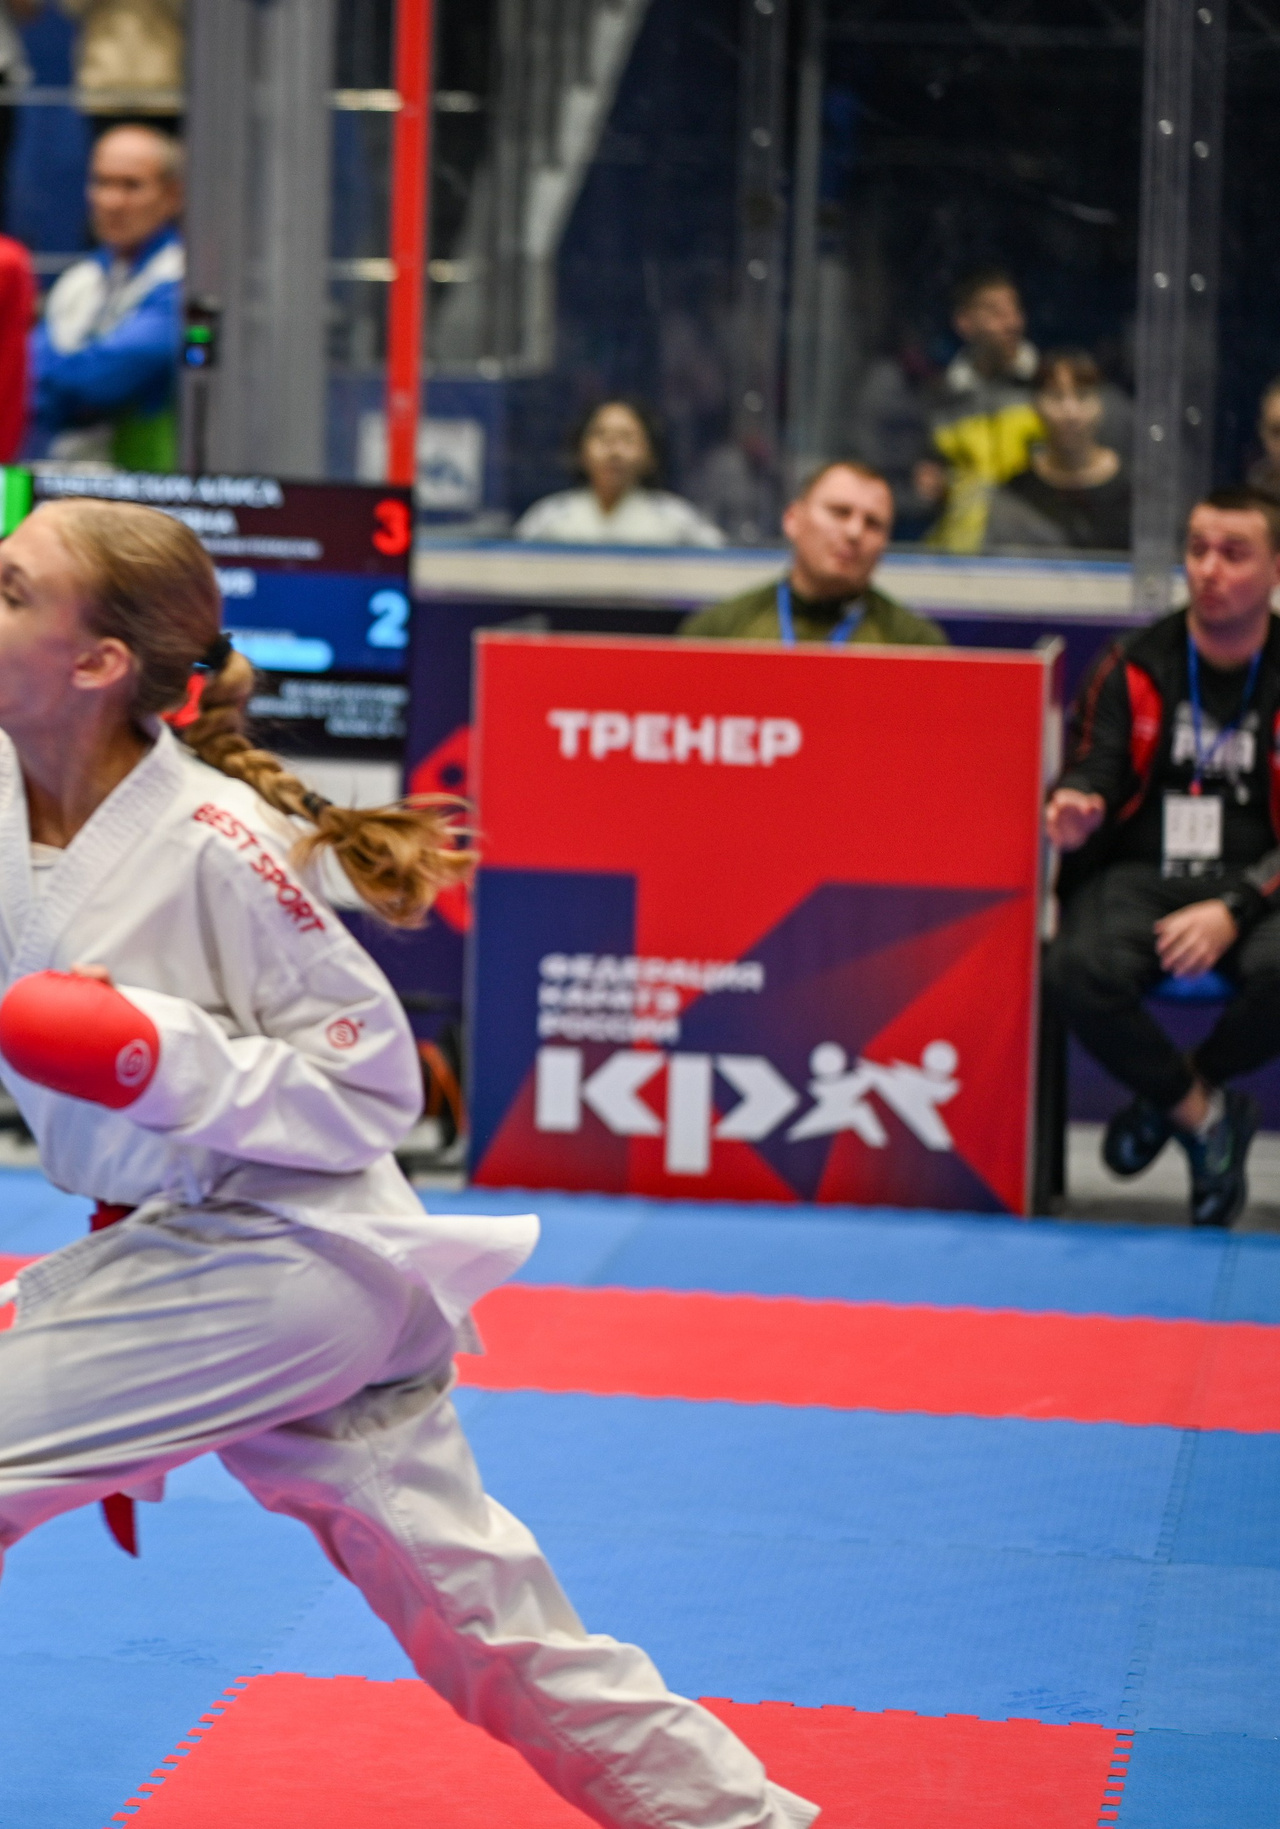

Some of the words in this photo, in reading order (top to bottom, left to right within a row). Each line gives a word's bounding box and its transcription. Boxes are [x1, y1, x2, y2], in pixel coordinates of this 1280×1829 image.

[372, 499, 411, 556] 3
[367, 589, 410, 648] 2
[547, 709, 802, 766] ТРЕНЕР
[193, 803, 259, 851] BEST
[250, 852, 326, 932] SPORT
[539, 953, 764, 993] ФЕДЕРАЦИЯ
